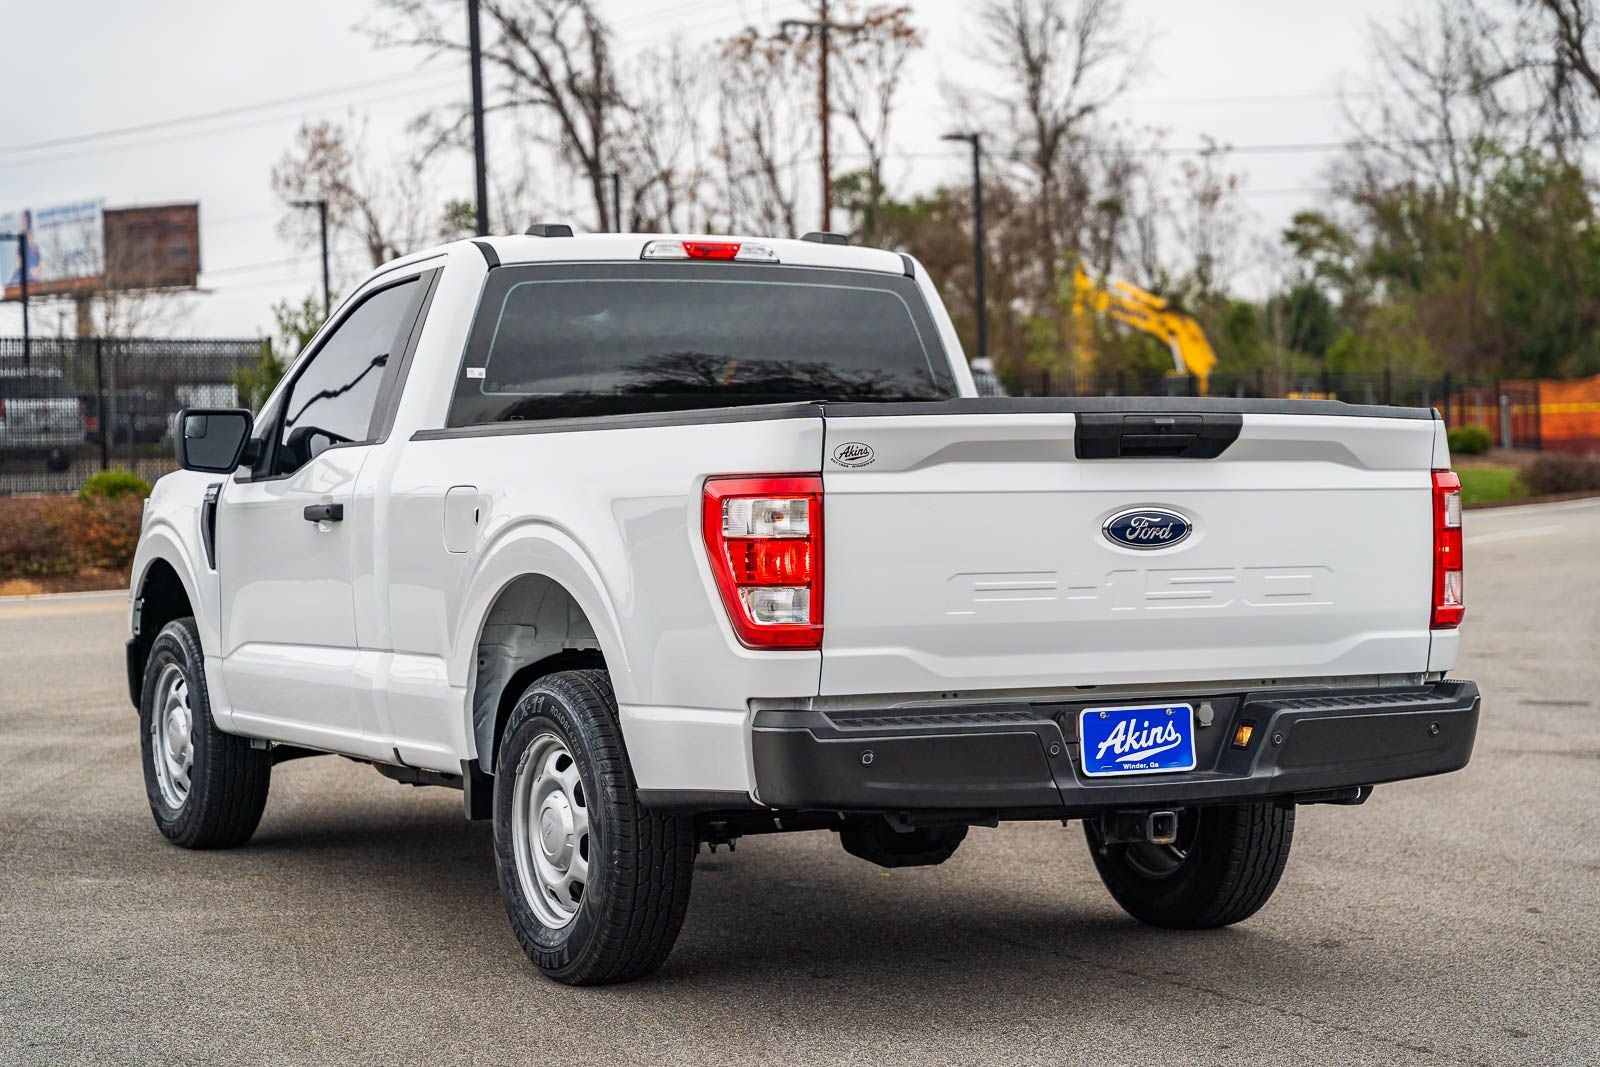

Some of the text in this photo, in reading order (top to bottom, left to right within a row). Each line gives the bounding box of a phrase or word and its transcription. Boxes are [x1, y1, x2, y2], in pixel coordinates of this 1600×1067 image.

[839, 445, 869, 459] Akins
[1126, 516, 1172, 540] Ford
[945, 565, 1334, 615] F-150
[1096, 719, 1182, 761] Akins
[1150, 761, 1159, 769] Ga
